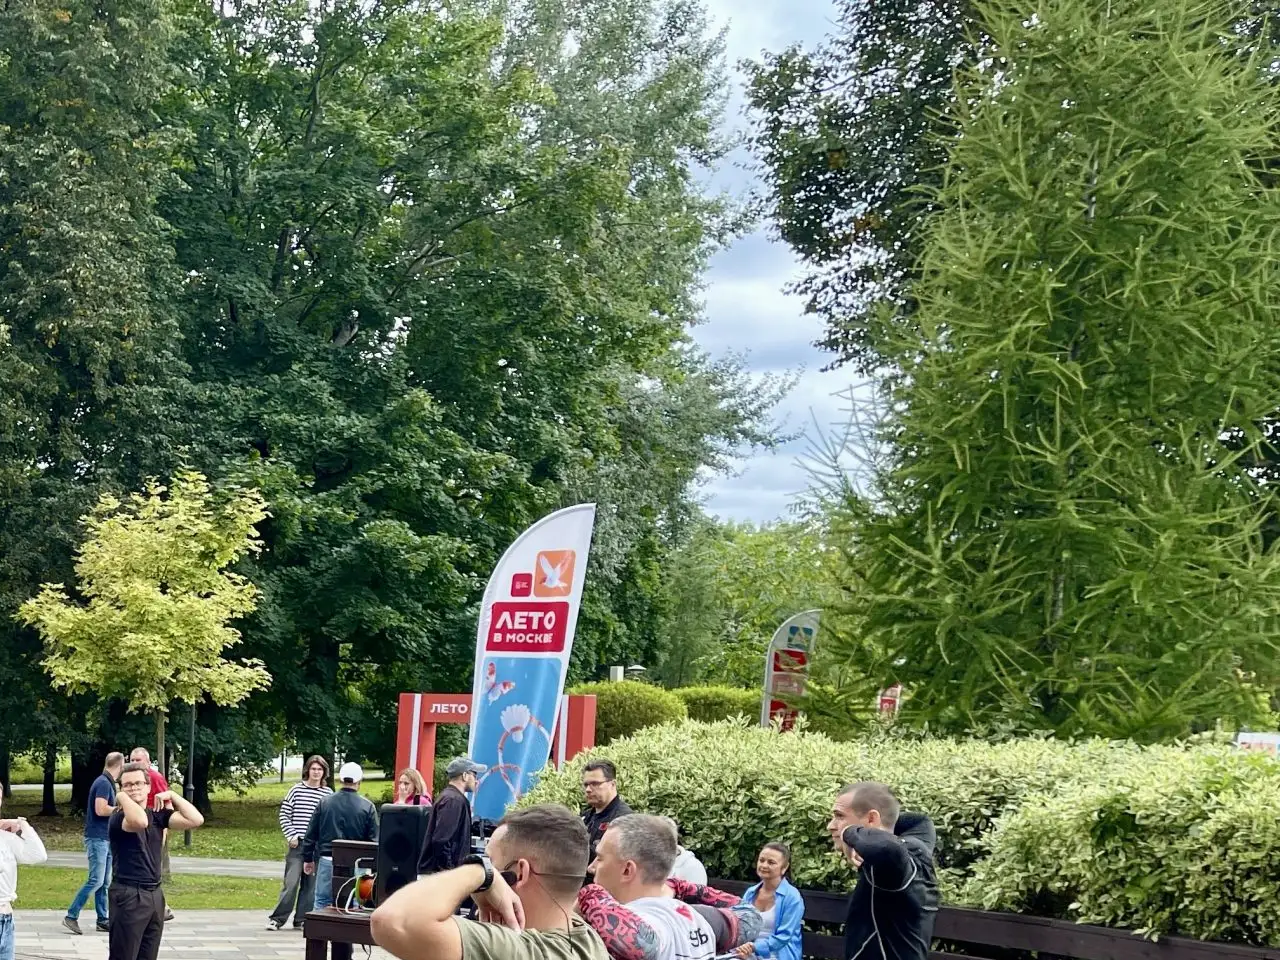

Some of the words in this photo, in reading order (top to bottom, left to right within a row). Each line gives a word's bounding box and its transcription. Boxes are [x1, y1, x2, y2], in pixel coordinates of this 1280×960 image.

[495, 611, 556, 630] ЛЕТО
[493, 632, 502, 643] В
[506, 633, 553, 643] МОСКВЕ
[430, 703, 468, 714] ЛЕТО
